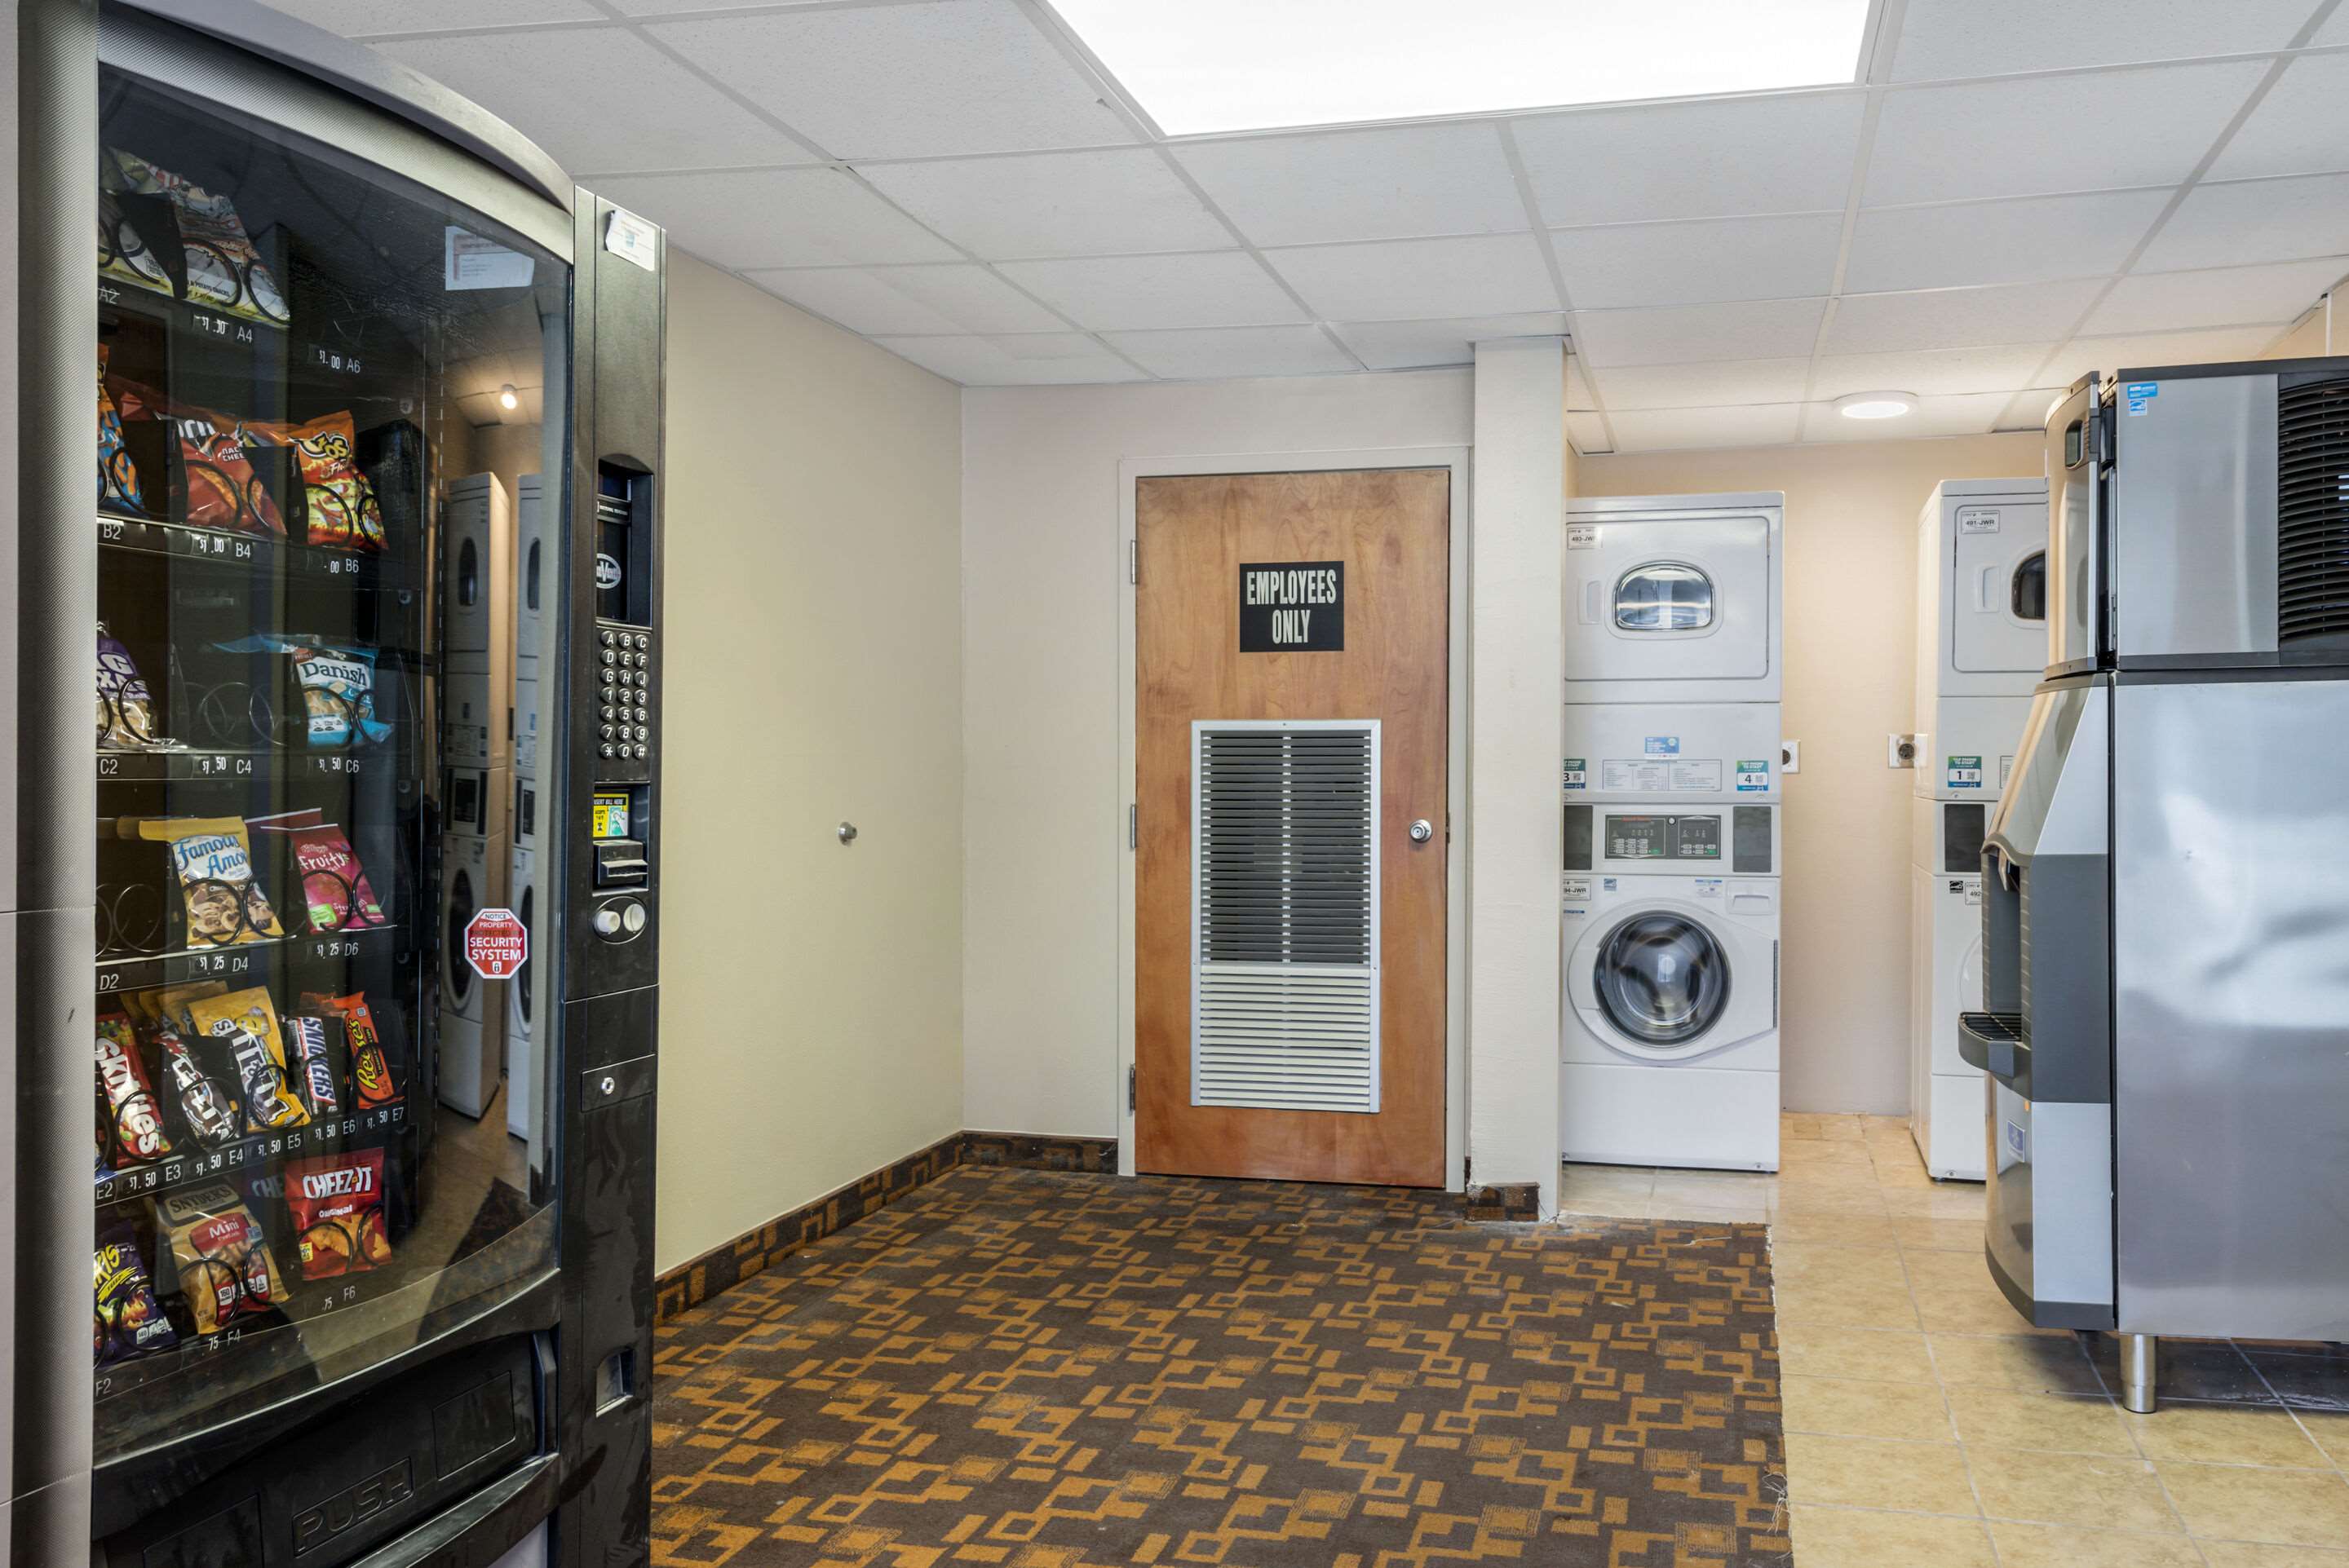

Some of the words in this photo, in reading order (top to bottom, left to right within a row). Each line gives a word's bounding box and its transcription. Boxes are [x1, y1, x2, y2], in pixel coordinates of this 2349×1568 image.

[99, 288, 118, 305] A2
[237, 325, 253, 343] A4
[347, 358, 361, 373] A6
[103, 524, 122, 540] B2
[235, 542, 251, 558] B4
[345, 559, 360, 573] B6
[1246, 569, 1337, 605] EMPLOYEES
[1272, 609, 1311, 644] ONLY
[607, 634, 614, 644] A
[624, 635, 631, 646] B
[639, 638, 647, 648] C
[607, 652, 614, 663] D
[623, 654, 630, 665] E
[639, 656, 646, 666] F
[300, 662, 367, 687] Danish
[606, 672, 613, 682] G
[622, 673, 631, 683] H
[639, 674, 646, 685] J
[608, 691, 613, 700] 1
[623, 691, 630, 702] 2
[639, 692, 646, 703] 3
[606, 709, 613, 719] 4
[622, 709, 630, 720] 5
[639, 710, 646, 721] 6
[606, 727, 613, 738] 7
[622, 728, 630, 738] 8
[639, 728, 646, 739] 9
[100, 758, 118, 775] C2
[237, 758, 252, 774] C4
[346, 759, 360, 773] C6
[1564, 772, 1570, 782] 3
[1745, 775, 1751, 784] 4
[1958, 771, 1962, 780] 1
[299, 851, 347, 870] Fruity
[344, 942, 359, 956] D6
[469, 937, 523, 947] SECURITY
[471, 949, 521, 961] SYSTEM
[232, 956, 249, 972] D4
[100, 974, 119, 990] D2
[302, 1017, 335, 1101] SNICKERS
[392, 1106, 405, 1122] E7
[343, 1119, 356, 1135] E6
[287, 1133, 301, 1150] E5
[228, 1147, 244, 1166] E4
[165, 1164, 182, 1182] E3
[95, 1182, 113, 1200] E2
[209, 1218, 240, 1239] Mini
[343, 1286, 356, 1301] F6
[228, 1328, 241, 1345] F4
[95, 1378, 112, 1397] F2
[297, 1470, 411, 1553] PUSH
